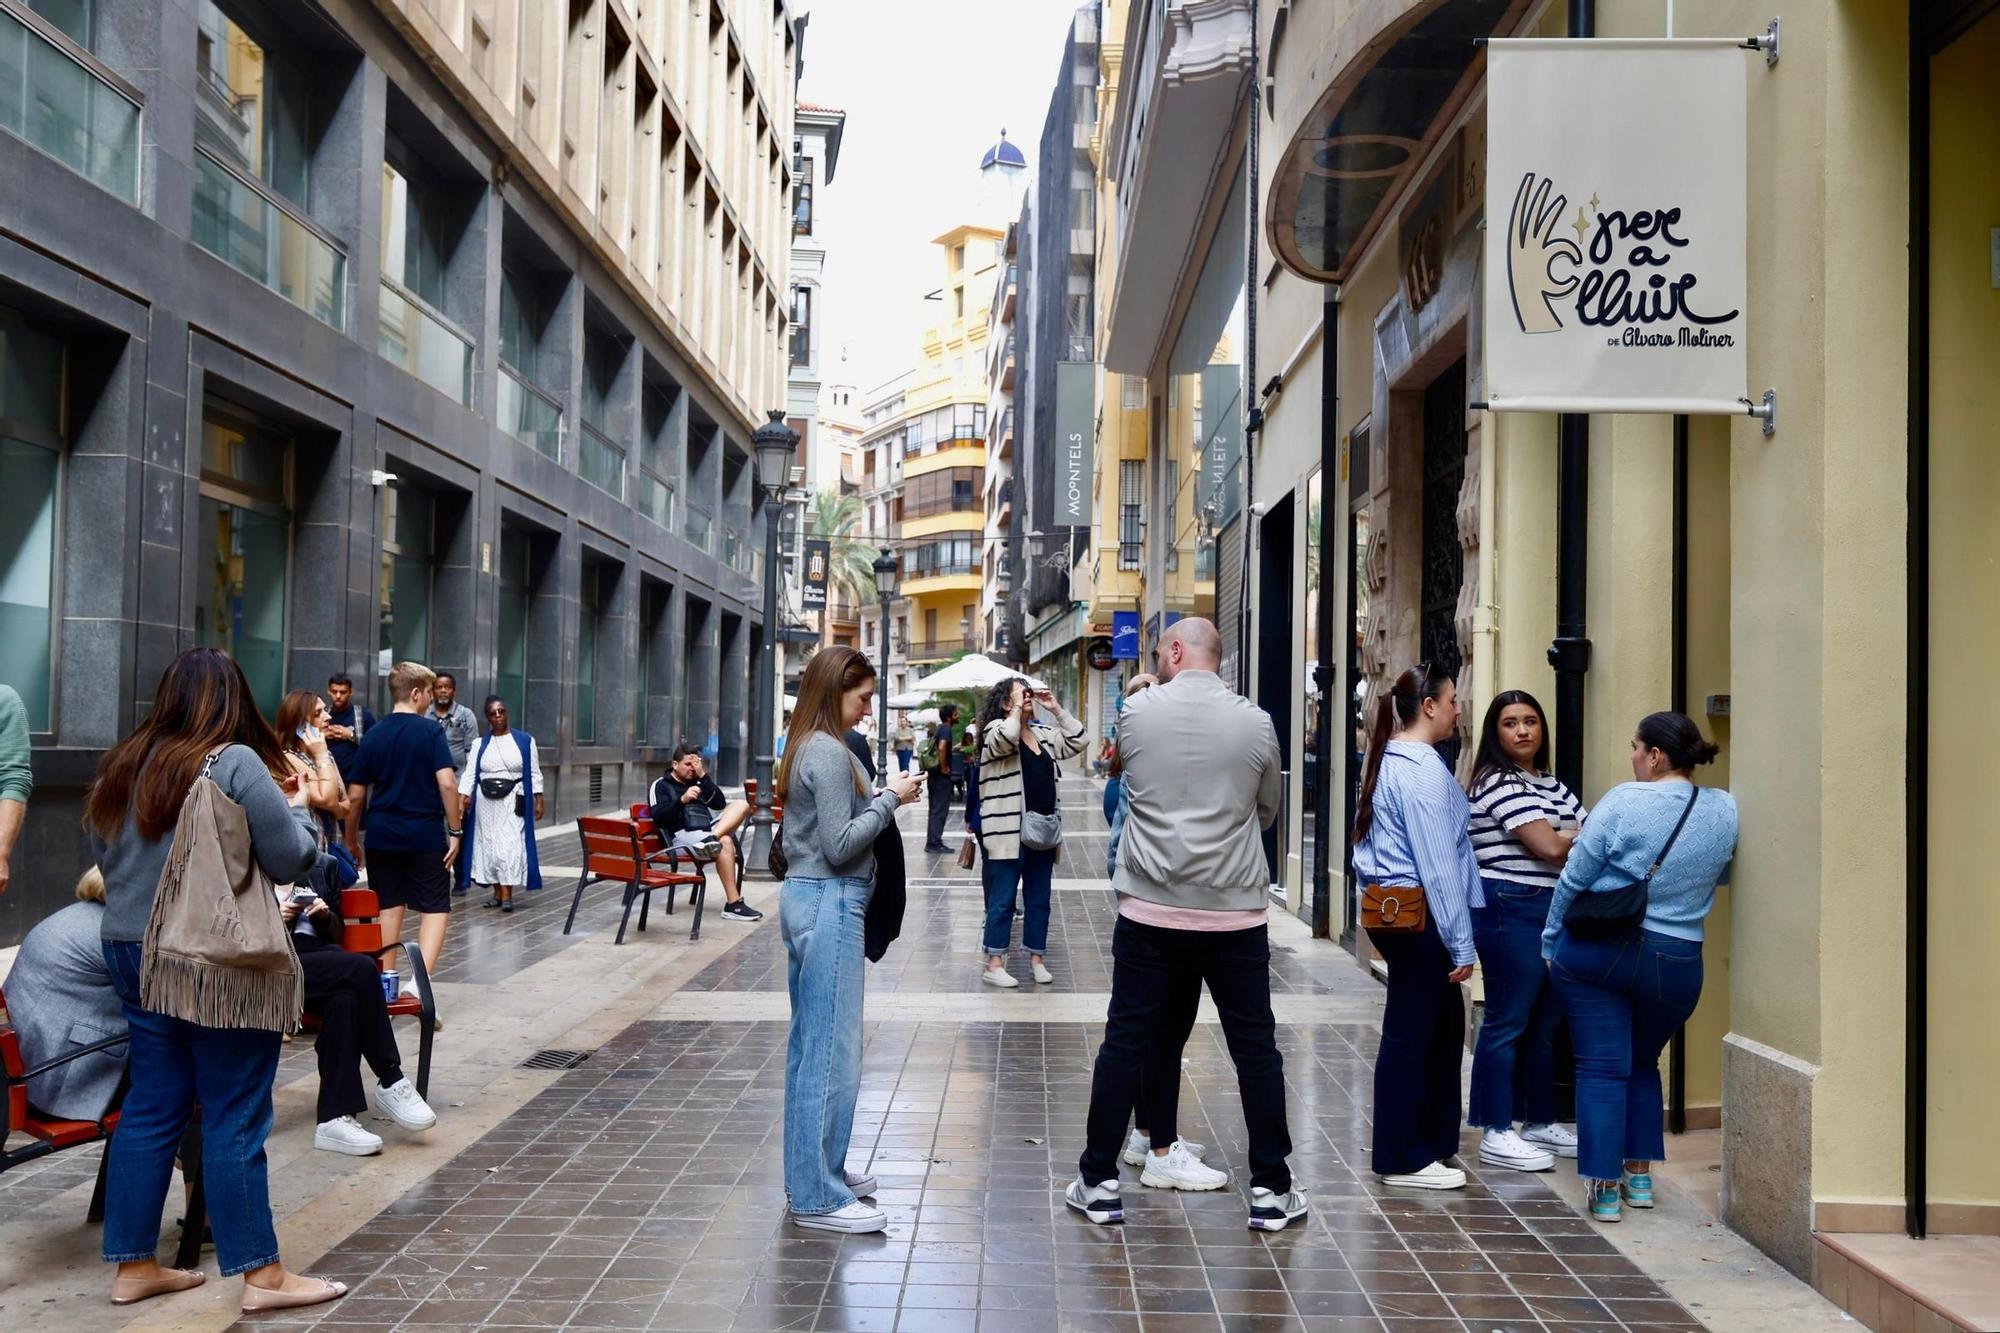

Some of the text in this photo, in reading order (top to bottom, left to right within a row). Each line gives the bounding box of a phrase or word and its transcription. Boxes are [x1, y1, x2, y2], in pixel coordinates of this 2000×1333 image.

[1589, 207, 1689, 265] per
[1628, 245, 1671, 267] a
[1575, 268, 1740, 327] lluir
[1607, 337, 1621, 346] DE
[1678, 326, 1735, 348] Moliner
